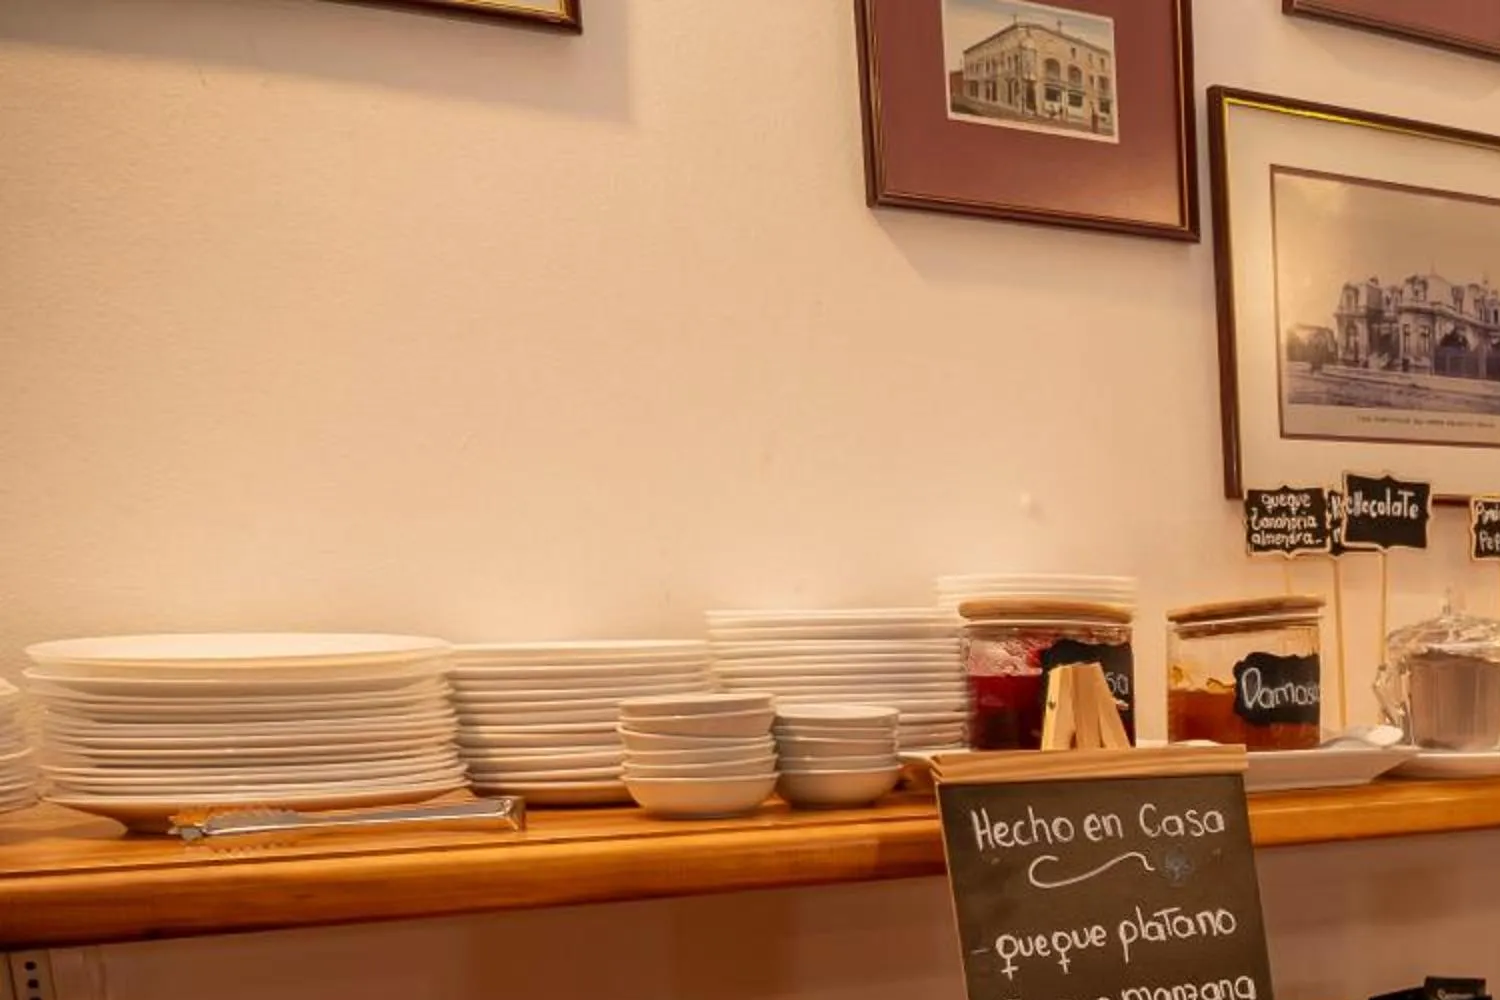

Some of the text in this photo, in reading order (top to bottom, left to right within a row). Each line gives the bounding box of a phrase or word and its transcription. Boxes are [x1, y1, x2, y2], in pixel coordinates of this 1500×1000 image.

[970, 803, 1225, 851] Hecho en Casa
